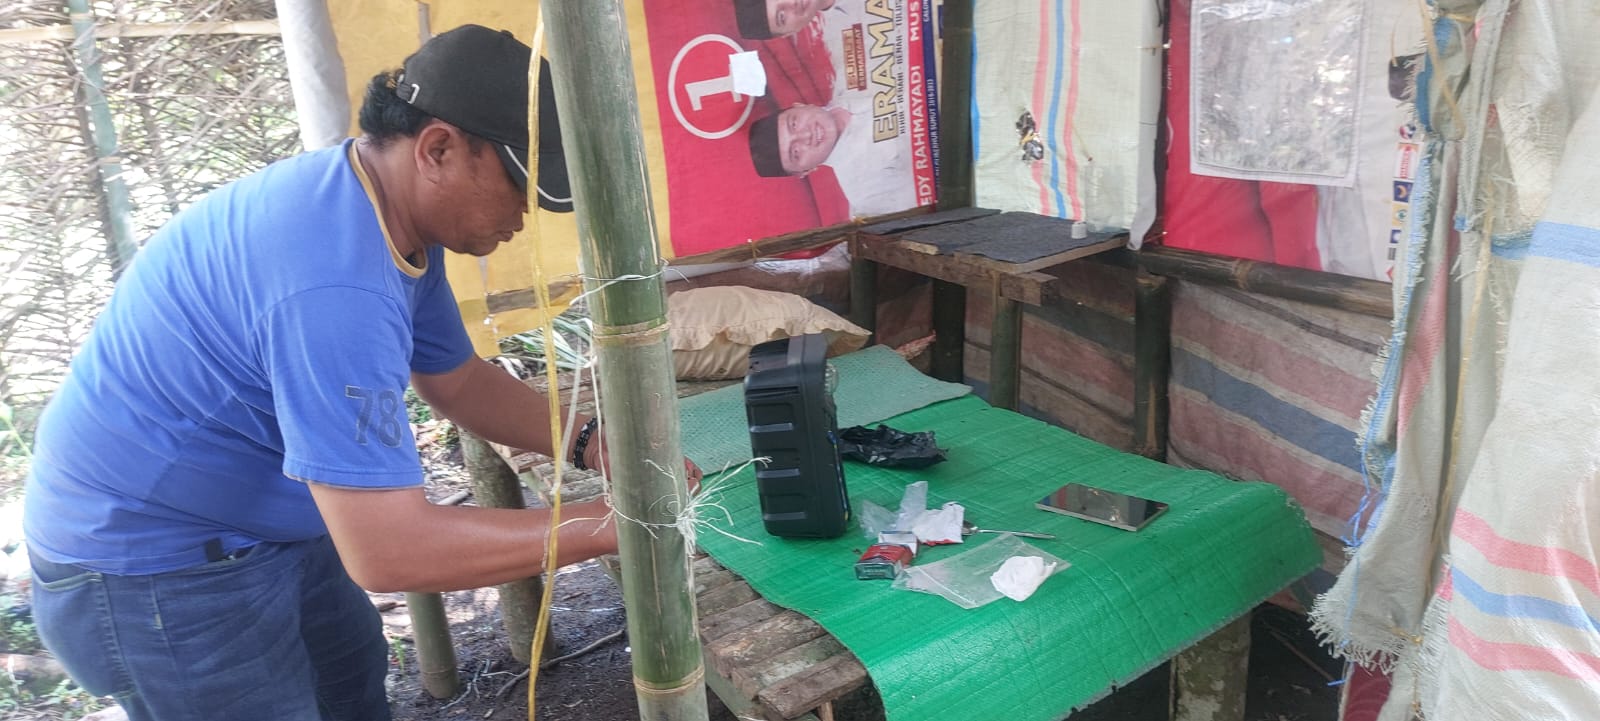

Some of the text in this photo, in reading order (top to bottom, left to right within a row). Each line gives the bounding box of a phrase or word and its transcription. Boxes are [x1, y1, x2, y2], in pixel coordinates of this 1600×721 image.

[910, 0, 921, 41] MUS
[684, 63, 742, 112] 1
[910, 65, 929, 170] RAHMAYADI
[929, 108, 938, 131] SUMUT
[345, 385, 402, 448] 78
